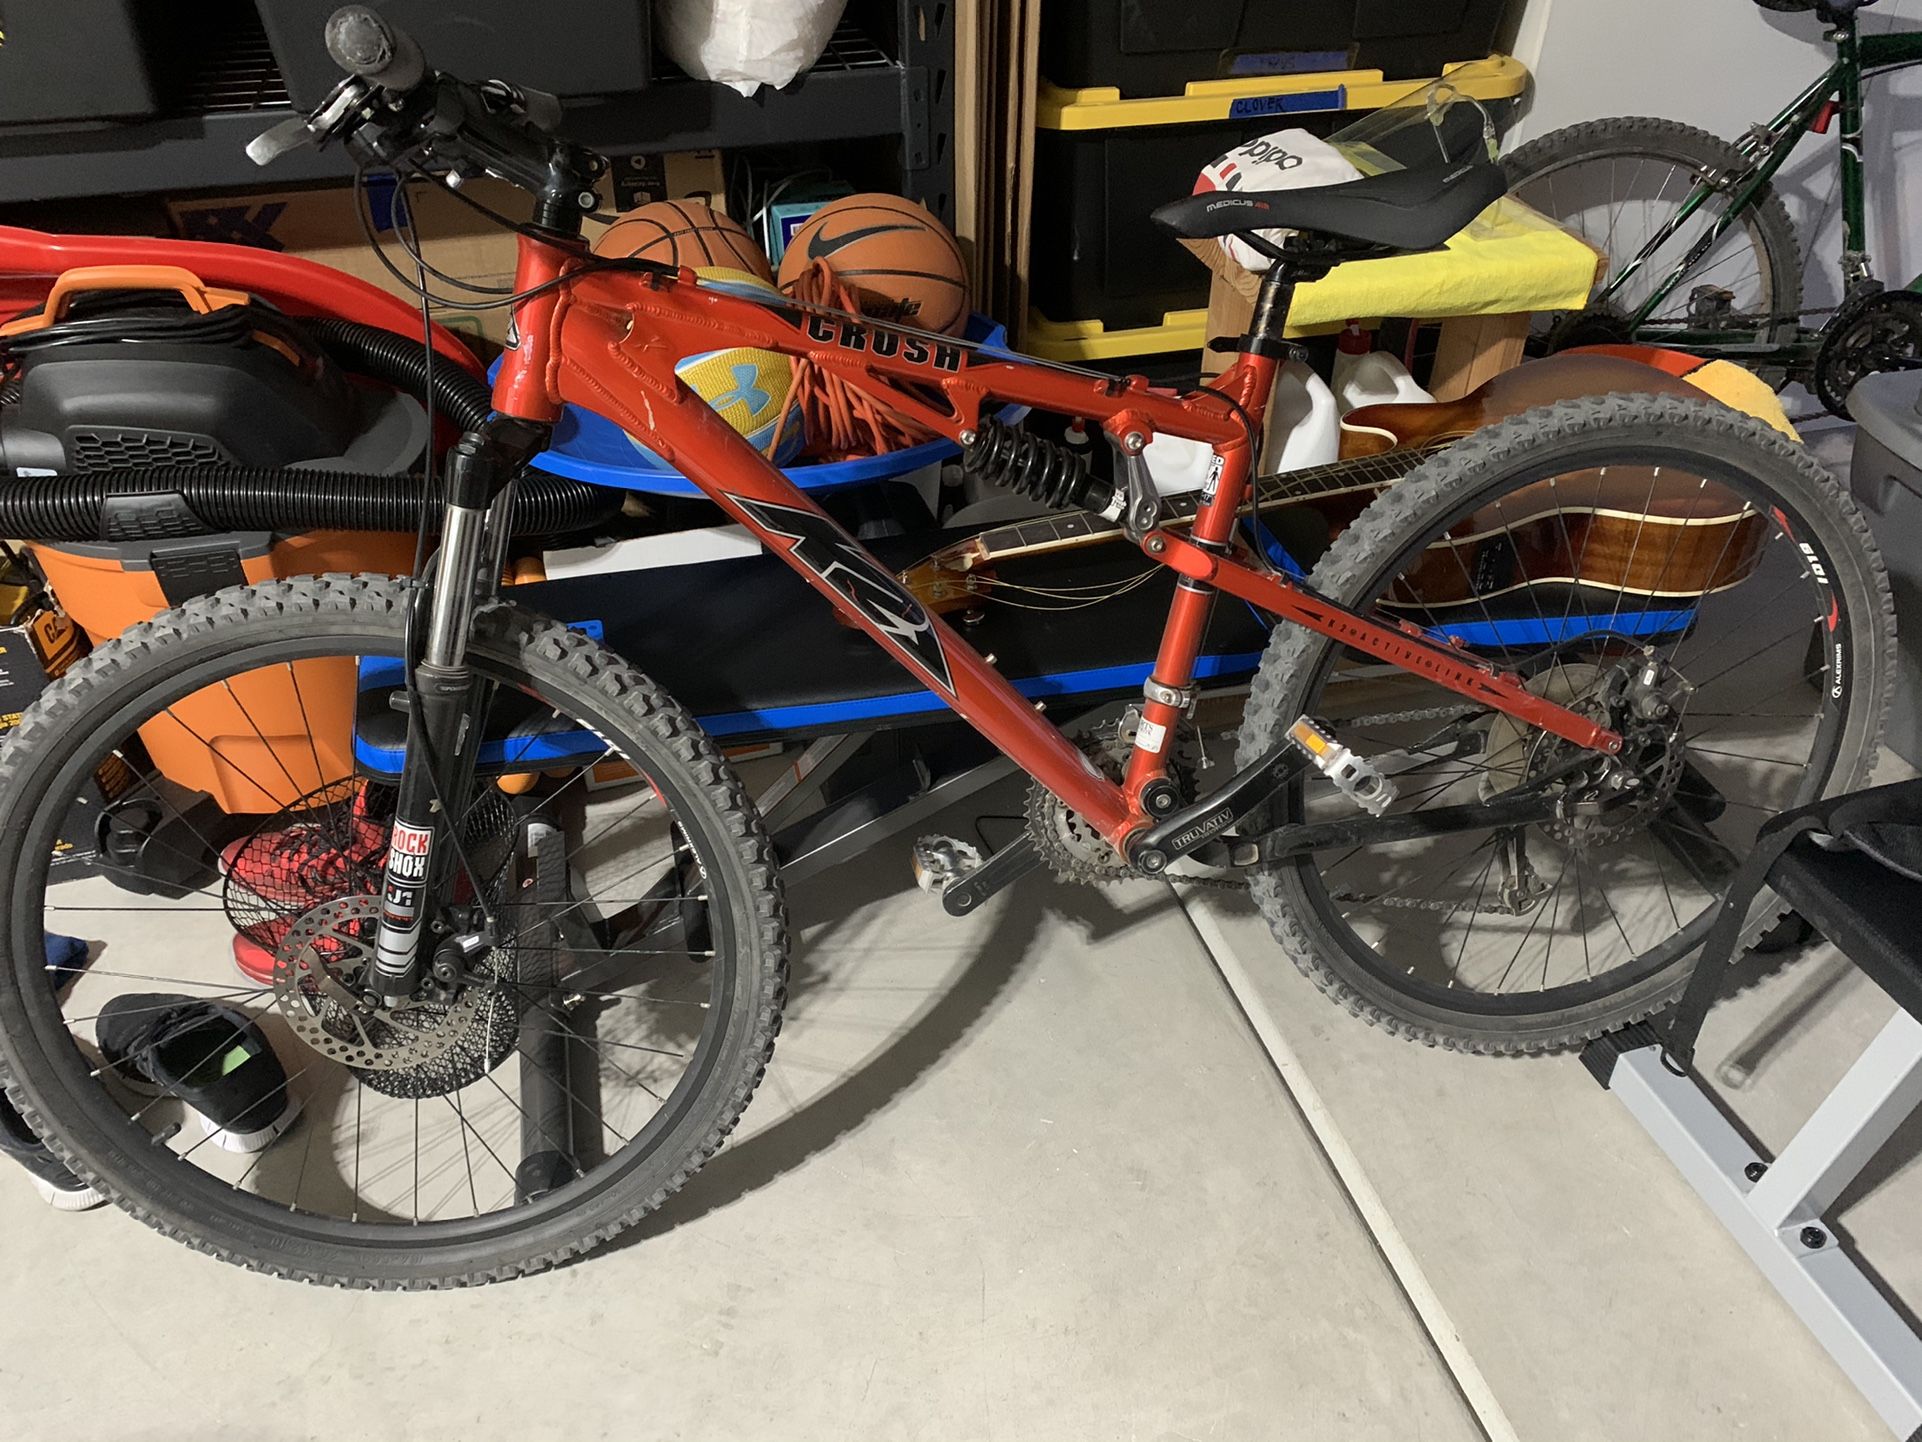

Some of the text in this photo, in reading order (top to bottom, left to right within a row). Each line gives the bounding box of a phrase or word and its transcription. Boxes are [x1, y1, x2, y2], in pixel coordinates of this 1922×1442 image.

[1206, 199, 1253, 212] MEDICUS
[806, 314, 963, 374] CRUSH
[392, 825, 429, 853] ROCK
[1173, 809, 1231, 848] TRUVATIV
[388, 848, 426, 878] SHOX
